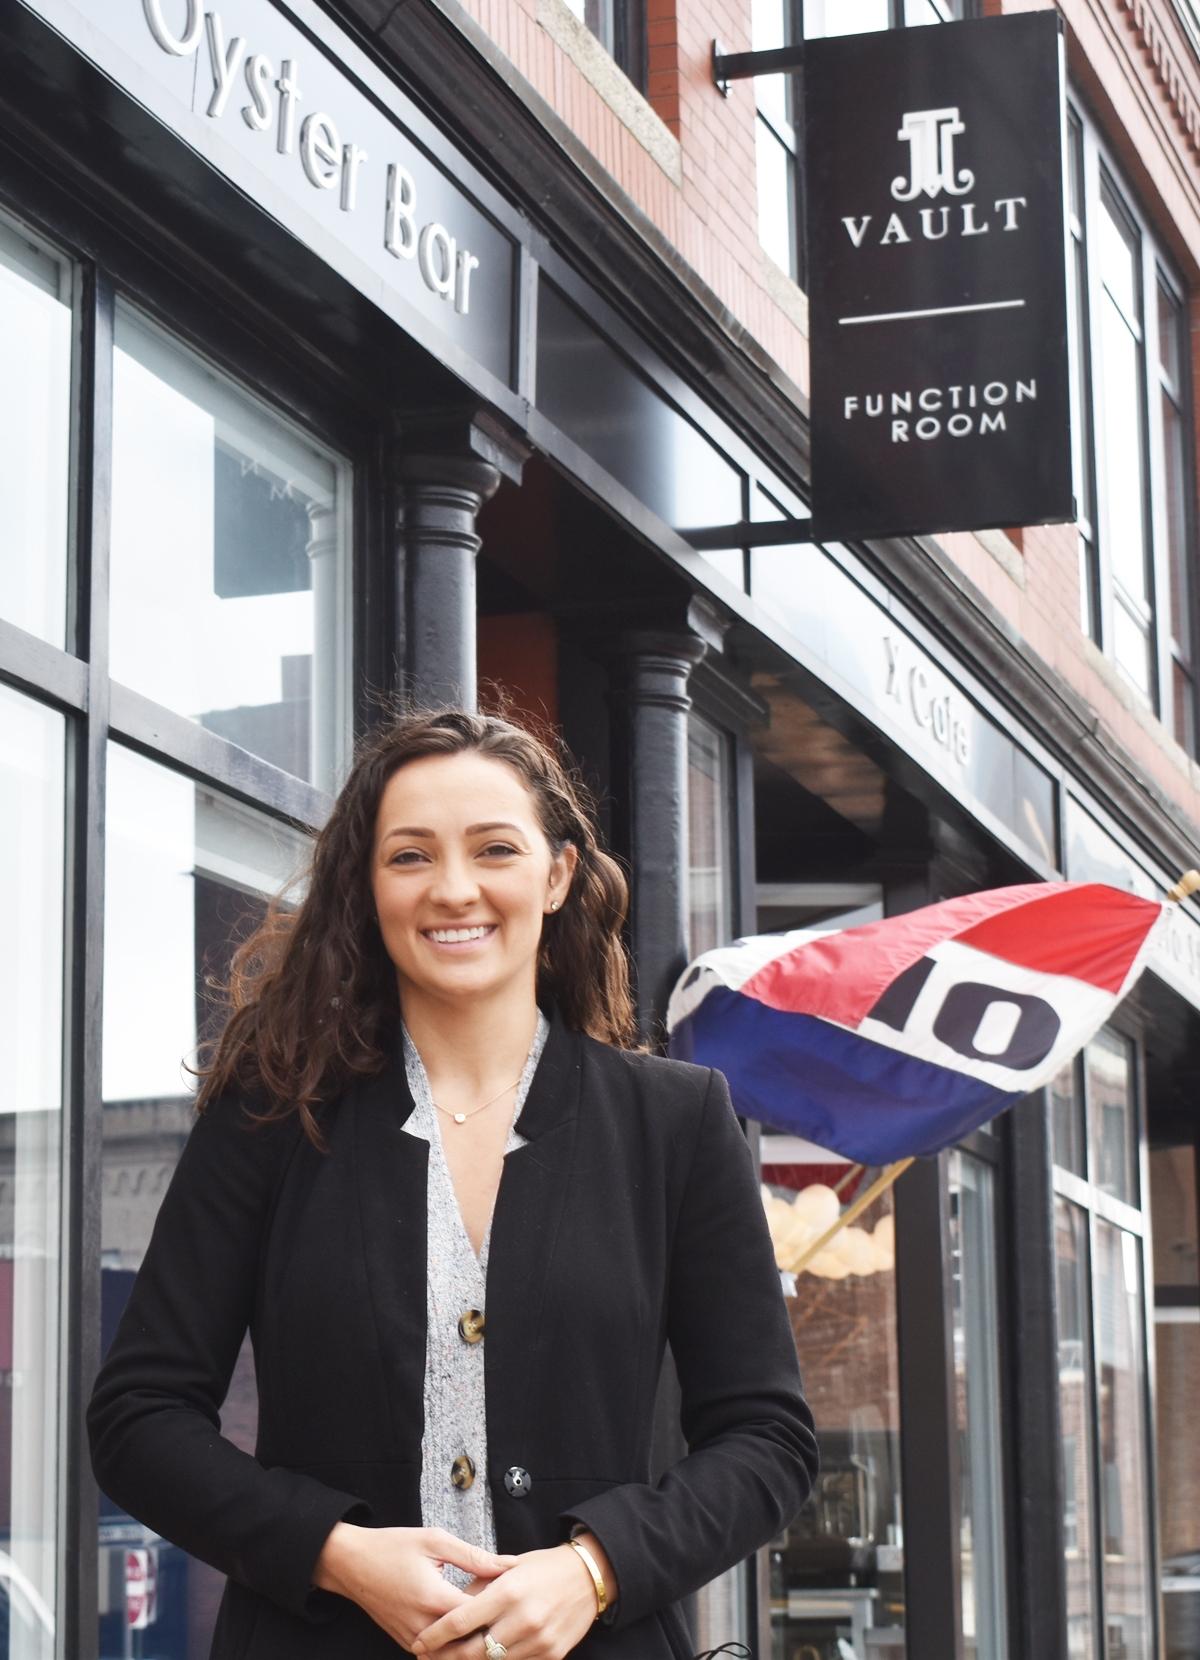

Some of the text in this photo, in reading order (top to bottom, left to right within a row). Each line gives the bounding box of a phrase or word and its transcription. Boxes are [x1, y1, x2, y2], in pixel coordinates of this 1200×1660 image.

[384, 162, 479, 315] Bar
[841, 196, 1027, 248] VAULT
[844, 378, 1037, 420] FUNCTION
[891, 411, 1007, 443] ROOM
